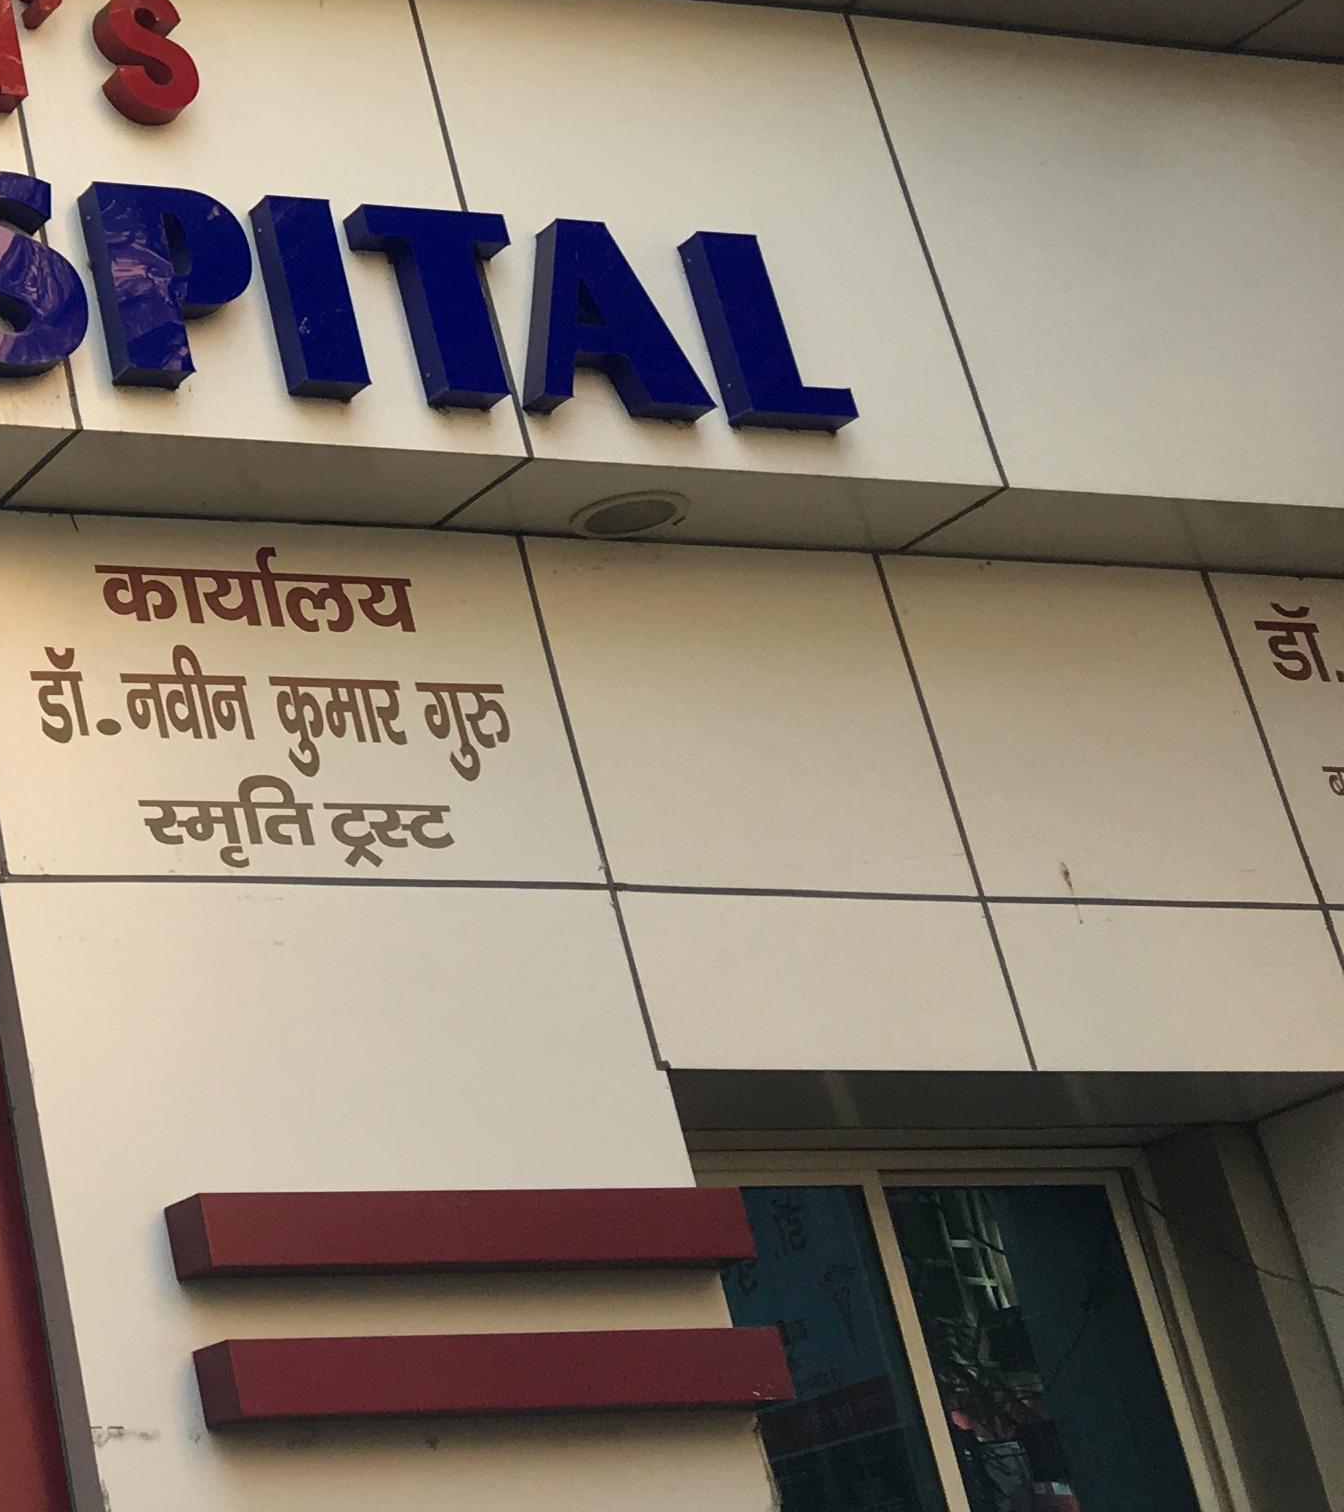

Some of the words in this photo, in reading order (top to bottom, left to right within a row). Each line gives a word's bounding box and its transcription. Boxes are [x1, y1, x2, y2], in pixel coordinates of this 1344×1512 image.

[94, 546, 417, 633] कार्यालय
[267, 675, 409, 778] कुमार
[414, 681, 511, 782] गुरु
[137, 774, 316, 868] स्मृति
[322, 802, 456, 868] ट्रस्ट
